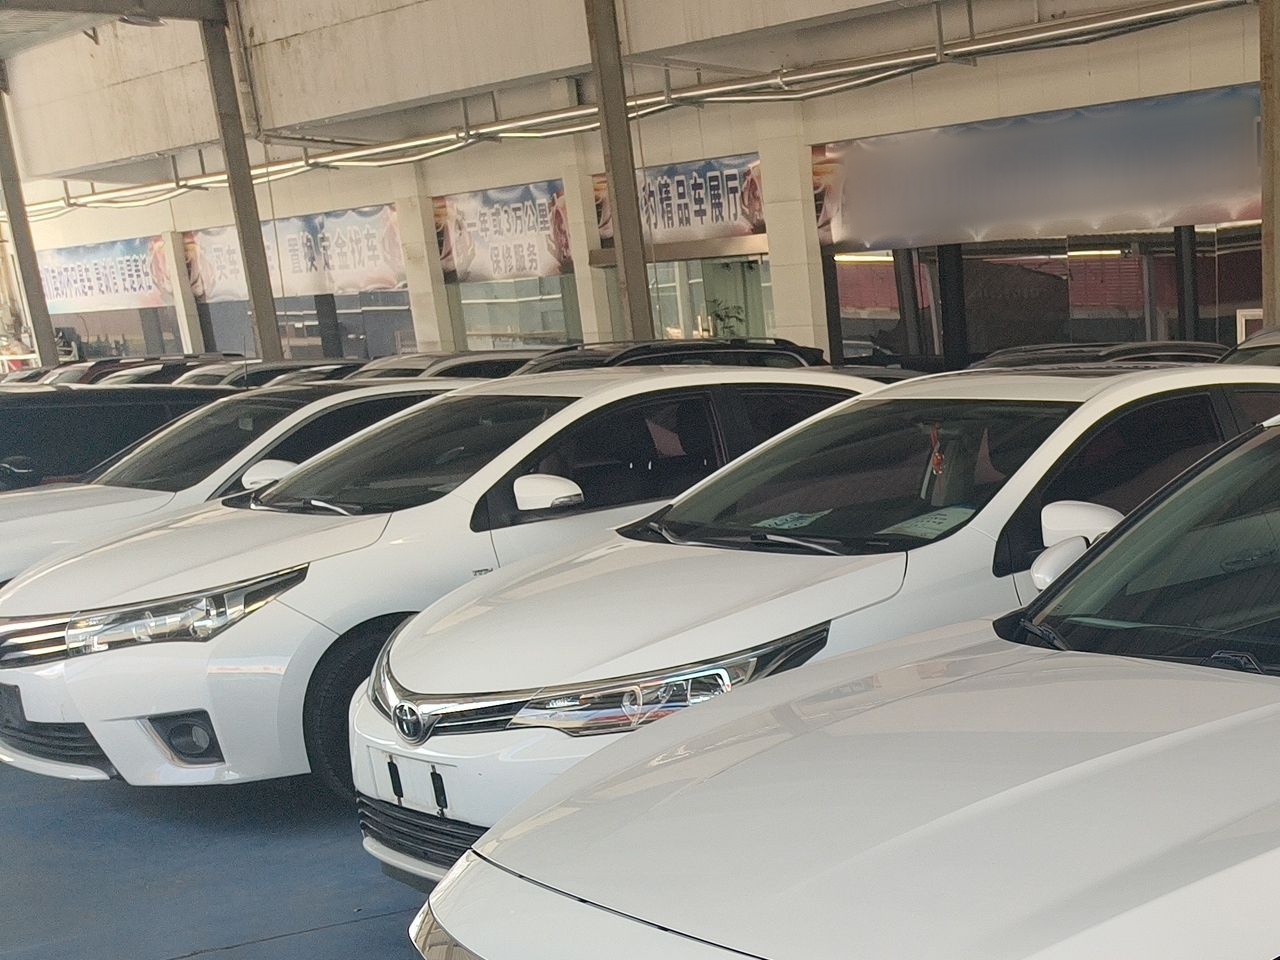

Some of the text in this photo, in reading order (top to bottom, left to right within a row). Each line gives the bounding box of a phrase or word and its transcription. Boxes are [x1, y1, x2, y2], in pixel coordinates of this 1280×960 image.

[466, 201, 551, 239] 一年或3万公里
[489, 242, 539, 275] 保修服务
